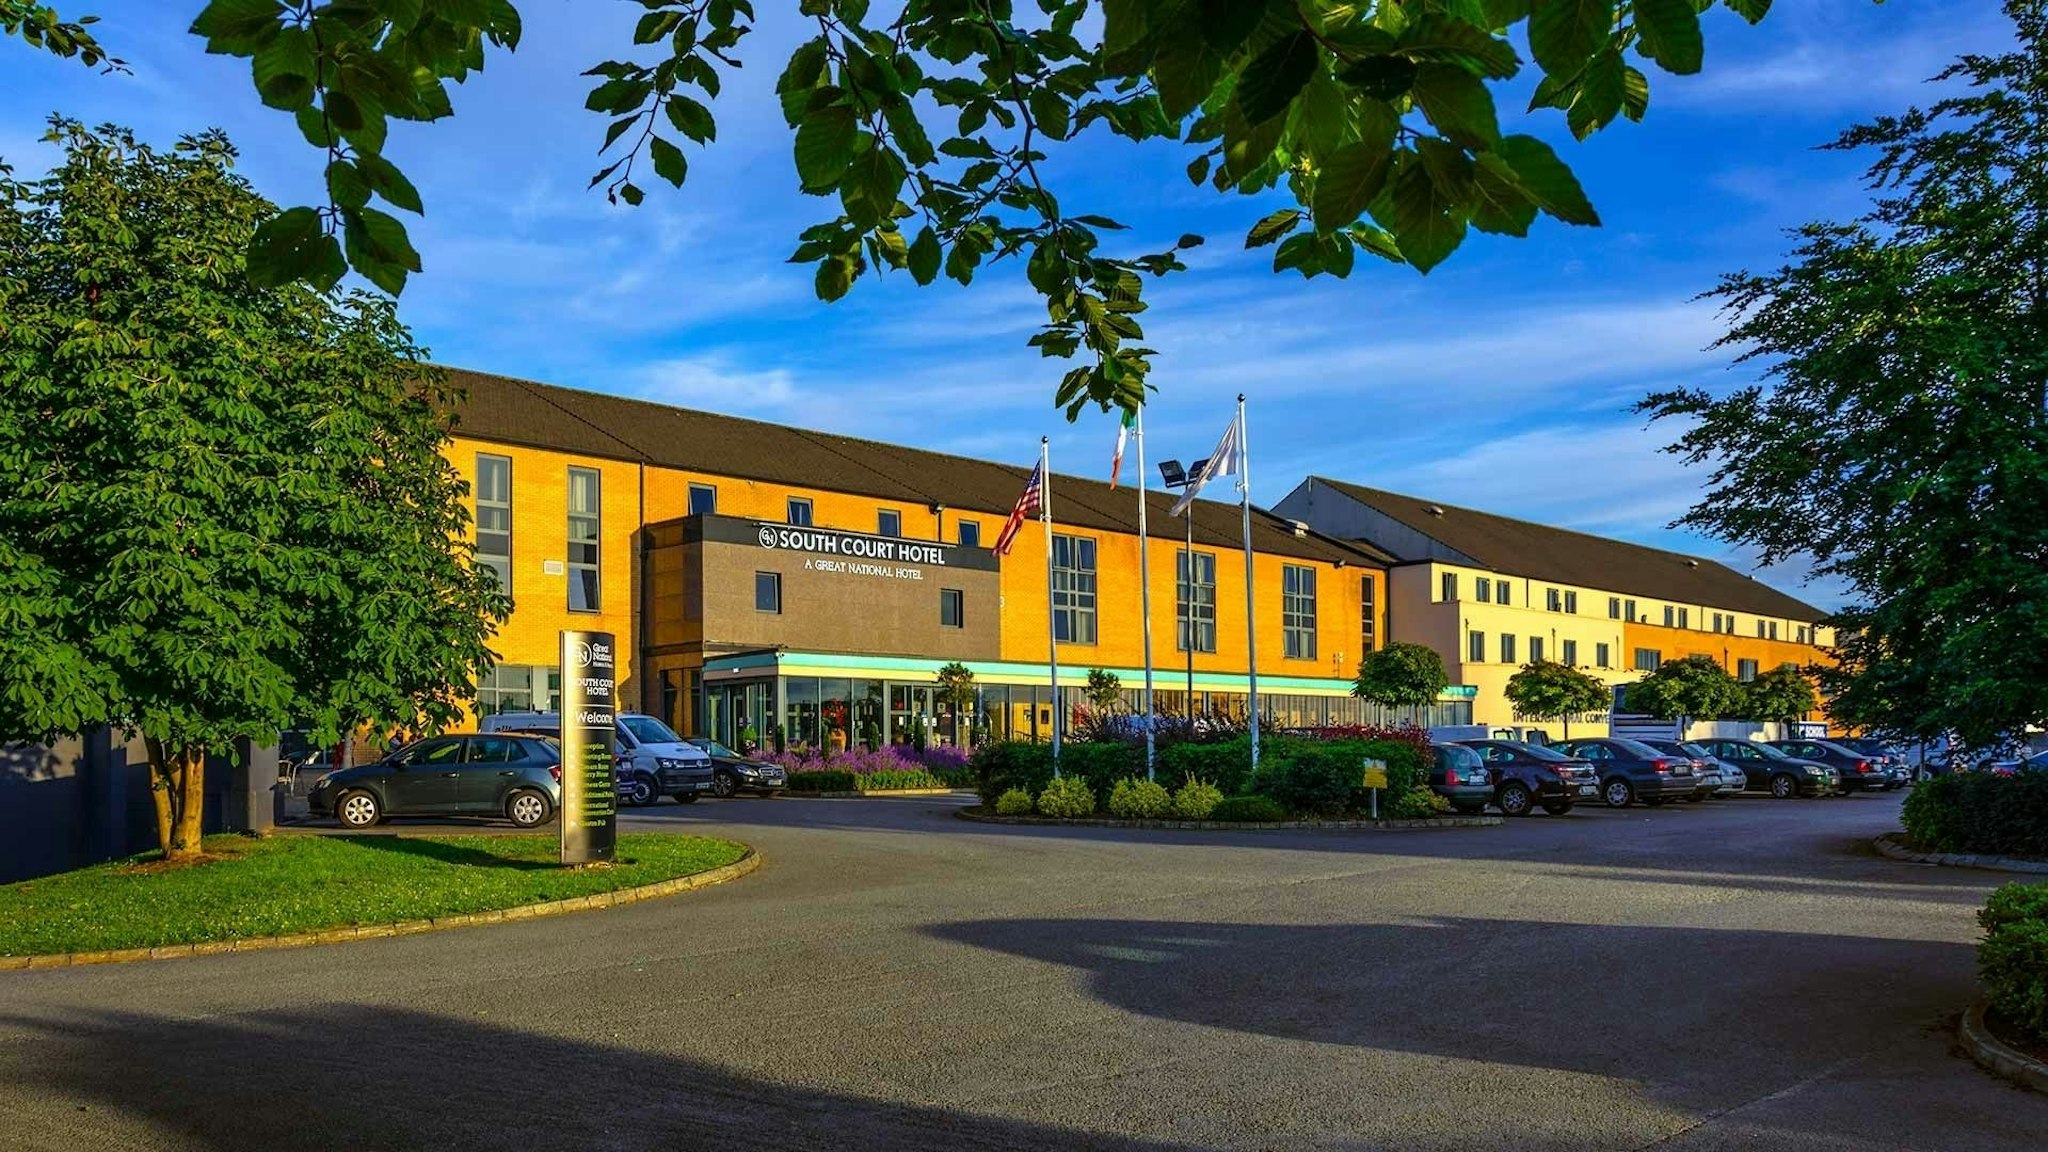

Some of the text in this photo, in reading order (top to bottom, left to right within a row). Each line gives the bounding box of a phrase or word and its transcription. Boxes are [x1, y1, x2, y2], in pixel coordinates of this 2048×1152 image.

[779, 531, 837, 553] SOUTH
[841, 537, 894, 559] COURT
[898, 544, 945, 565] HOTEL
[804, 558, 924, 580] A GREAT NATIONAL HOTEL
[575, 677, 599, 687] OUTH
